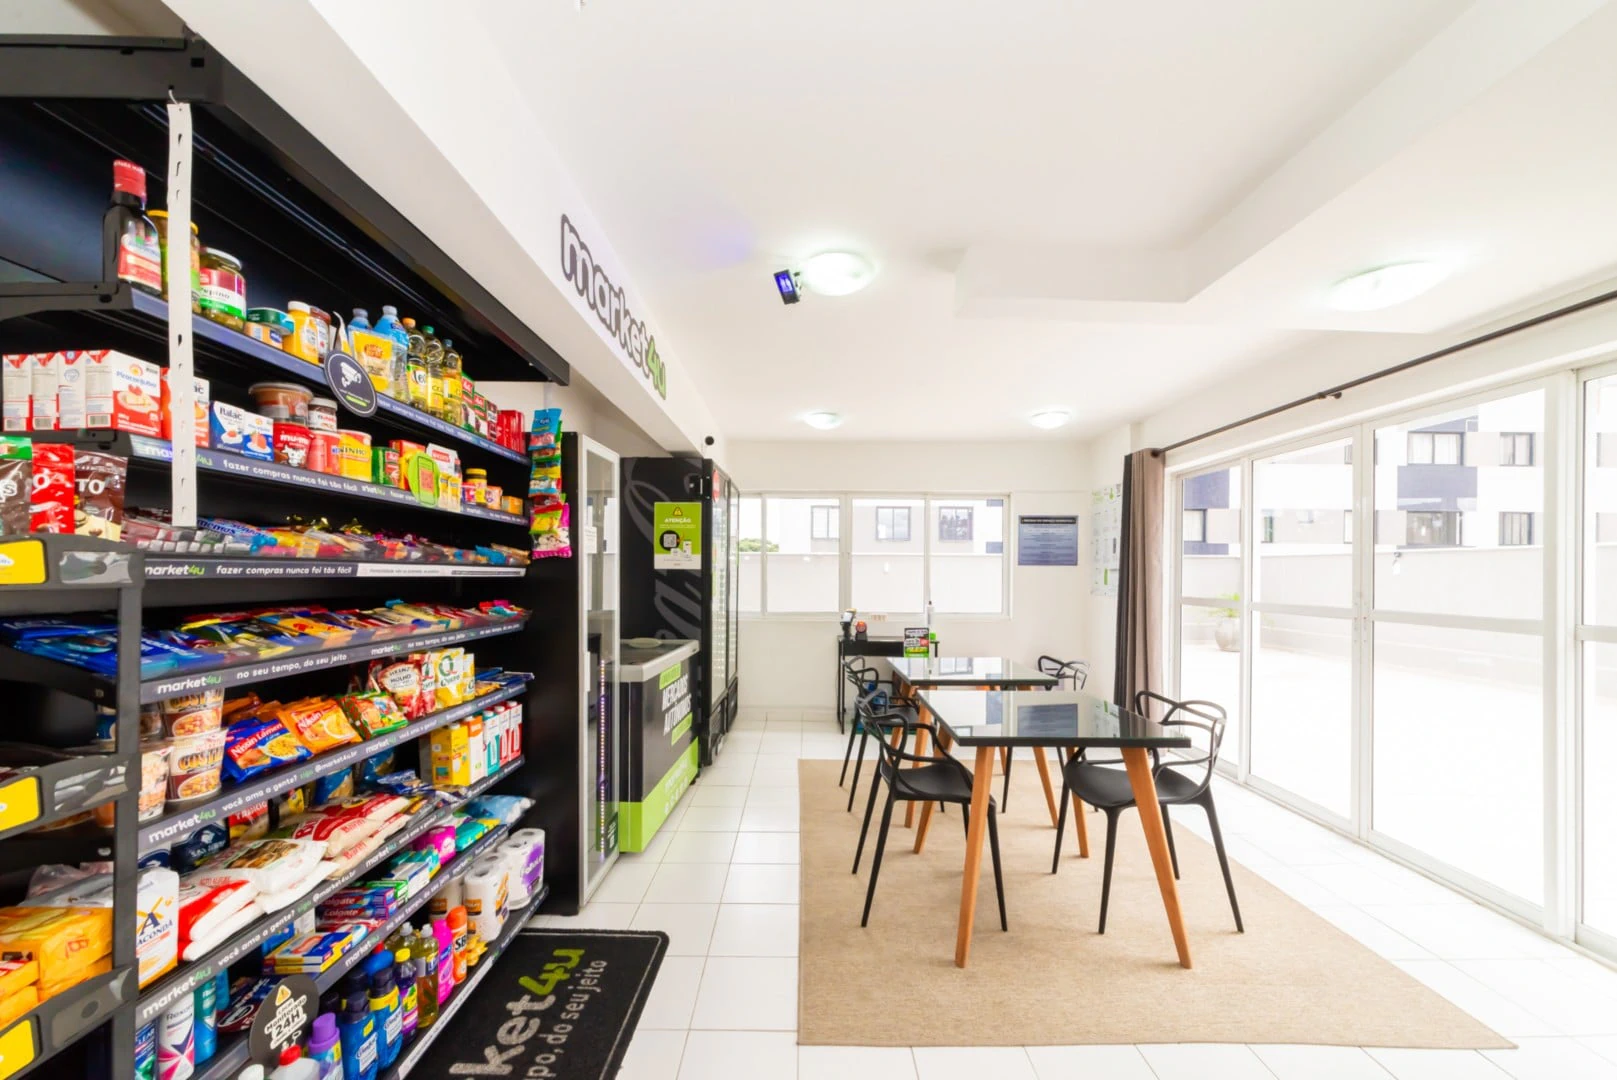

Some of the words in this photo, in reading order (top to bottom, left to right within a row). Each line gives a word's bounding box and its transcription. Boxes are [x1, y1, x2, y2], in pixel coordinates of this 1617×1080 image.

[561, 213, 667, 401] market4u
[223, 459, 250, 472] fazer
[253, 466, 291, 480] compras
[216, 564, 243, 575] fazer
[246, 566, 284, 577] compras
[286, 566, 310, 575] nunca
[157, 674, 222, 694] market4u
[236, 671, 250, 680] no
[252, 667, 269, 677] seu
[271, 661, 301, 675] tempo,
[304, 658, 314, 668] do
[316, 656, 329, 665] seu
[148, 809, 217, 844] market4u
[222, 798, 244, 812] você
[246, 790, 264, 803] ama
[265, 786, 272, 794] a
[273, 774, 298, 792] gente?
[142, 967, 212, 1020] market4u
[218, 949, 240, 966] você
[241, 935, 261, 951] ama
[262, 928, 269, 937] a
[269, 908, 296, 933] gente?
[567, 959, 609, 993] jeito
[275, 1008, 301, 1037] 24H
[449, 948, 586, 1080] ket4u
[560, 991, 591, 1020] seu
[539, 1023, 574, 1045] do
